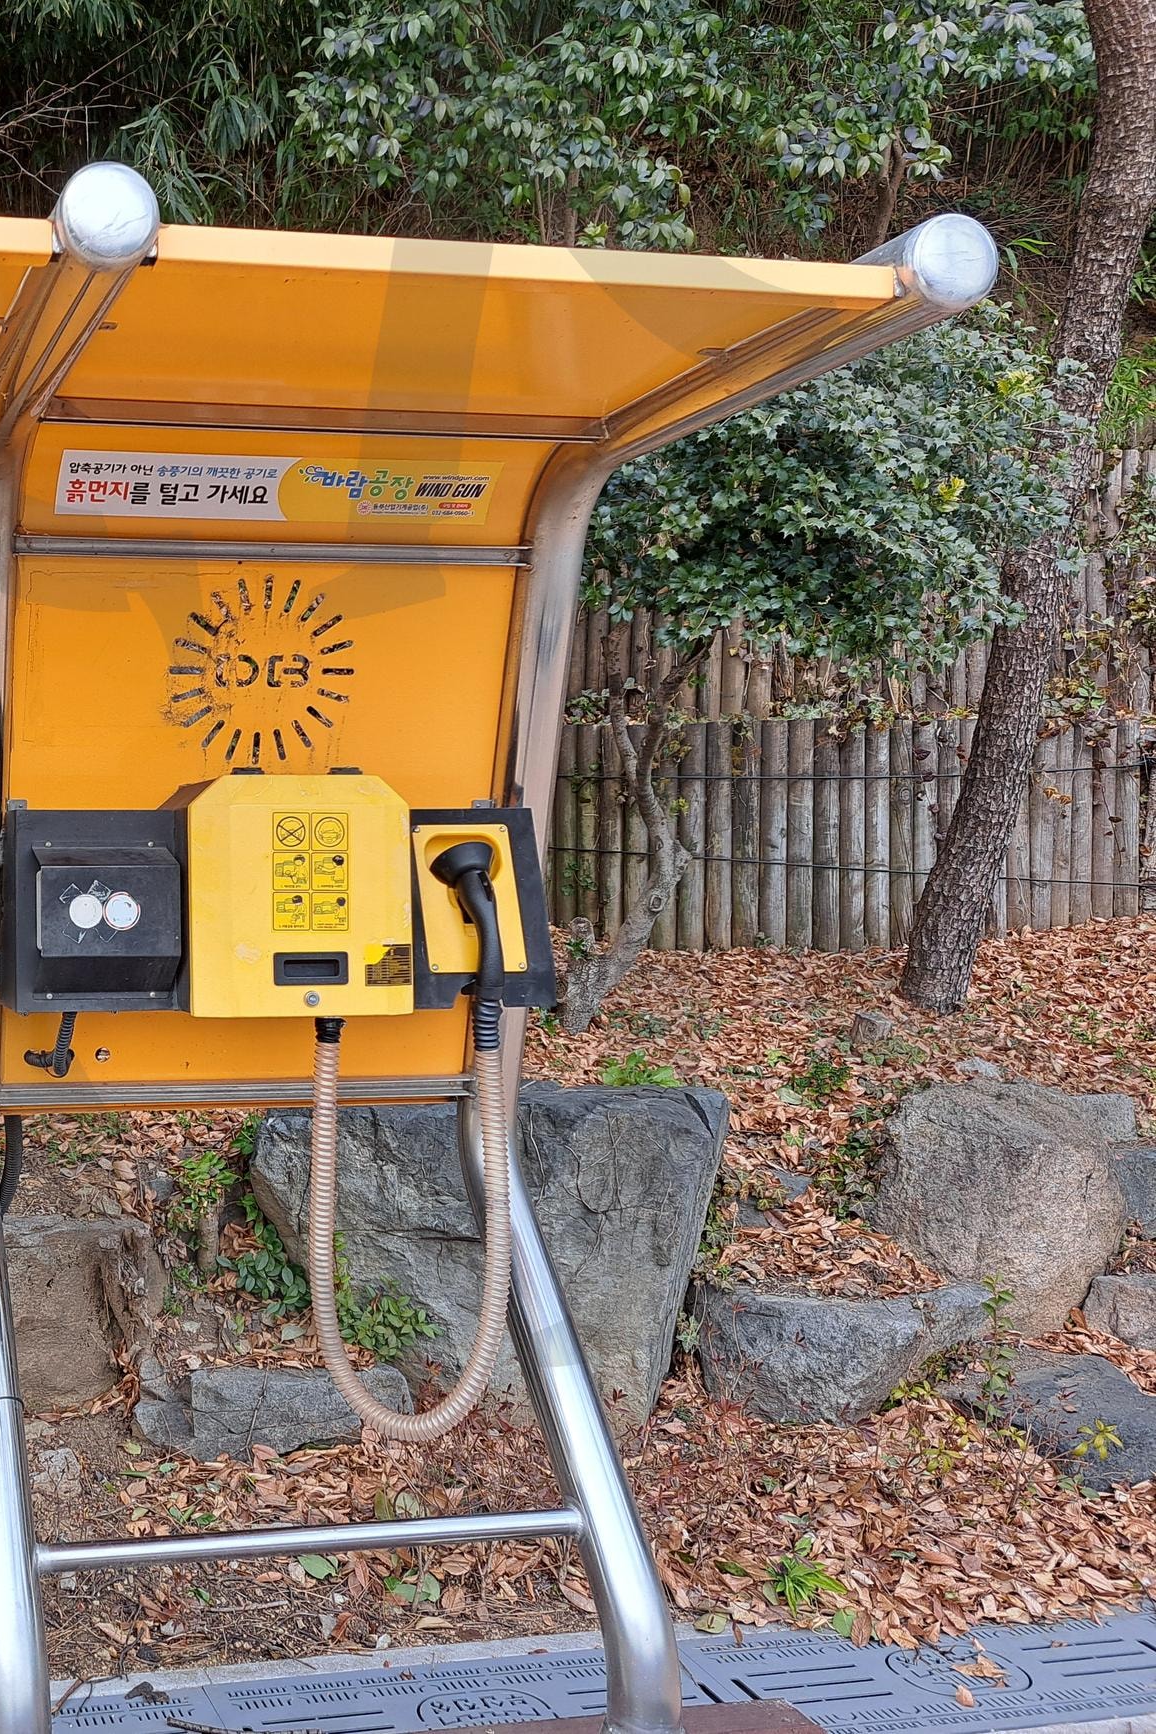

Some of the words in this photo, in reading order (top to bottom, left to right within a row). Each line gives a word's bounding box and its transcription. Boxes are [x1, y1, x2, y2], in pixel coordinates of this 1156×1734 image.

[69, 462, 127, 474] 압축공기가
[130, 464, 153, 476] 아닌
[157, 465, 203, 477] 송풍기의
[206, 467, 241, 478] 깨끗한
[244, 468, 278, 479] 공기로
[422, 474, 490, 483] www.windgun.com
[66, 479, 151, 505] 흙먼지를
[159, 483, 200, 506] 털고
[206, 484, 268, 505] 가세요
[320, 469, 414, 500] 바람공장
[414, 482, 451, 498] WIND
[451, 483, 488, 498] GUN
